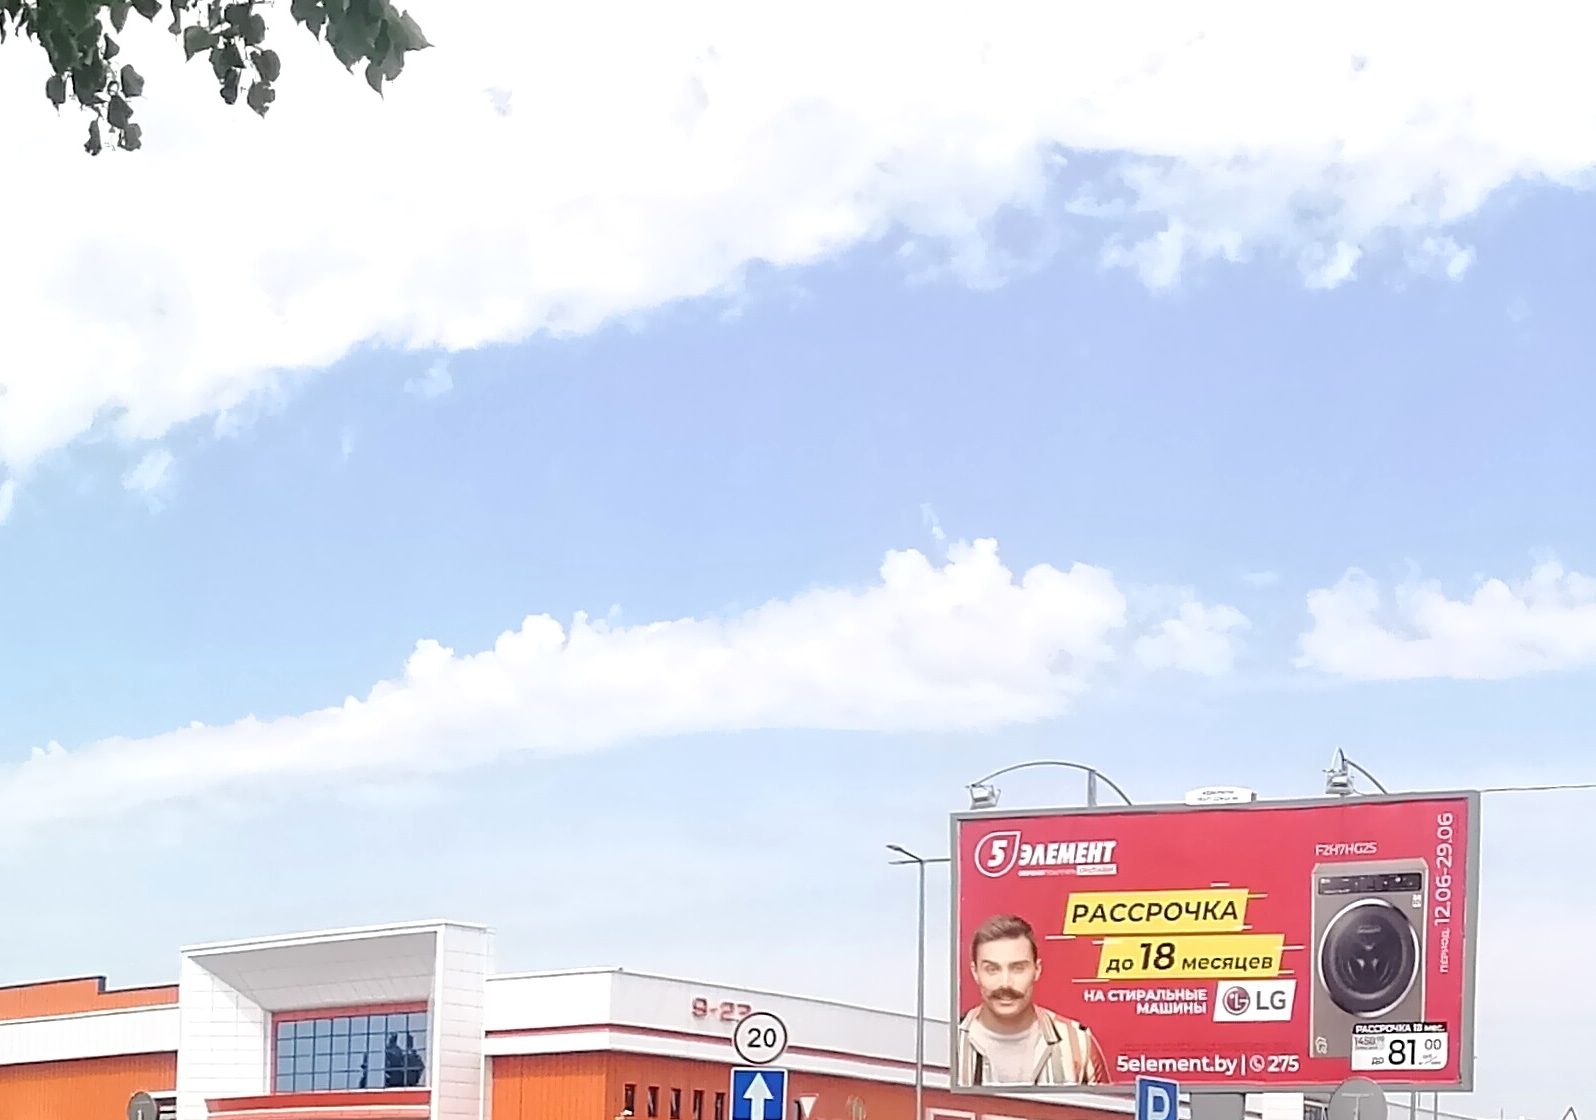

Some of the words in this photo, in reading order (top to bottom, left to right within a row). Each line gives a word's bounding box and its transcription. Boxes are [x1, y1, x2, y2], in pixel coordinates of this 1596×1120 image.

[987, 839, 1008, 867] 5
[1018, 840, 1117, 866] ЭЛЕМЕНТ
[1434, 812, 1454, 926] 12.06-29.06
[1071, 900, 1239, 923] РАССРОЧКА
[1105, 958, 1134, 974] до
[1140, 942, 1176, 971] 18
[1182, 955, 1274, 972] месяцев
[1084, 989, 1105, 1002] НА
[1107, 987, 1208, 1002] СТИРАЛЬНЫЕ
[1255, 990, 1287, 1011] LG
[1136, 1002, 1207, 1015] МАШИНЫ
[747, 1027, 777, 1048] 20
[1355, 1023, 1411, 1034] РАССРОЧКА
[1388, 1039, 1417, 1066] 81
[1424, 1039, 1442, 1050] 00
[1116, 1055, 1238, 1074] 5element.by
[1267, 1055, 1300, 1073] 275
